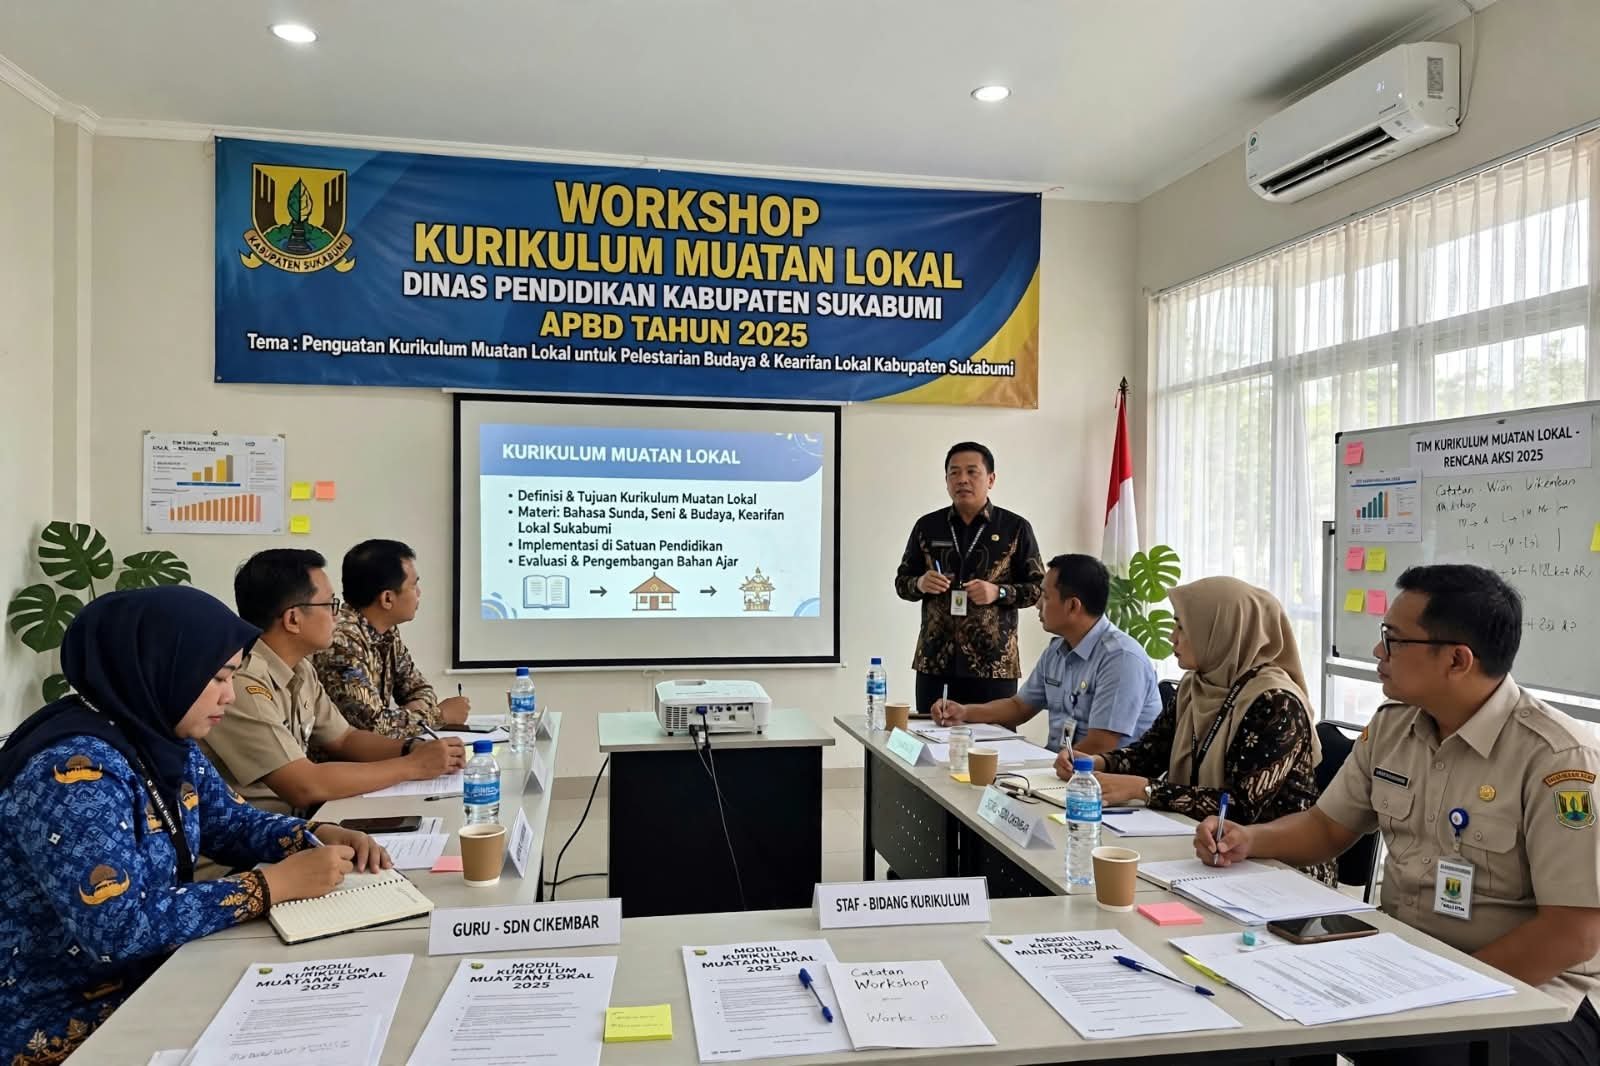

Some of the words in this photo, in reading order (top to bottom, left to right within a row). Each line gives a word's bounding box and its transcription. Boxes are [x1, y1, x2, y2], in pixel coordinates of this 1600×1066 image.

[555, 181, 820, 238] WORKSHOP
[249, 236, 300, 270] KABUPATEN
[304, 240, 349, 270] SUKABUMI
[415, 222, 663, 275] KURIKULUM
[675, 238, 834, 283] MUATAN
[845, 247, 963, 289] LOKAL
[403, 271, 488, 300] DINAS
[495, 275, 656, 307] PENDIDIKAN
[663, 284, 810, 315] KABUPATEN
[816, 292, 942, 320] SUKABUMI
[539, 311, 623, 341] APBD
[631, 316, 730, 346] TAHUN
[738, 321, 808, 348] 2025
[248, 333, 289, 351] Tema
[302, 335, 386, 356] Penguatan
[389, 339, 467, 358] Kurikulum
[471, 342, 527, 360] Muatan
[531, 344, 571, 361] Lokal
[575, 347, 617, 363] untuk
[621, 347, 700, 366] Pelestarian
[704, 351, 756, 371] Budaya
[760, 354, 770, 368] &
[774, 355, 831, 371] Kearifan
[835, 356, 871, 372] Lokal
[874, 357, 945, 376] Kabupaten
[949, 359, 1014, 377] Sukabumi
[1416, 440, 1432, 453] TIM
[1434, 434, 1489, 452] KURIKULUM
[1491, 430, 1535, 446] MUATAN
[1537, 426, 1573, 442] LOKAL
[502, 443, 606, 461] KURIKULUM
[611, 446, 682, 464] MUATAN
[686, 449, 741, 466] LOKAL
[1443, 453, 1489, 468] RENCANA
[1491, 450, 1515, 466] AKSI
[1517, 448, 1544, 463] 2025
[518, 489, 563, 503] Definisi
[566, 490, 575, 503] &
[577, 490, 617, 506] Tujuan
[620, 491, 679, 505] Kurikulum
[682, 492, 724, 505] Muatan
[727, 492, 757, 505] Lokal
[518, 506, 560, 519] Materi:
[563, 506, 606, 519] Bahasa
[608, 506, 648, 521] Sunda,
[651, 507, 676, 520] Seni
[679, 508, 688, 520] &
[690, 508, 735, 523] Budaya,
[738, 507, 785, 521] Kearifan
[518, 522, 550, 535] Lokal
[553, 522, 612, 535] Sukabumi
[518, 539, 599, 553] Implementasi
[601, 539, 613, 552] di
[616, 539, 657, 552] Satuan
[659, 540, 723, 552] Pendidikan
[518, 555, 568, 568] Evaluasi
[570, 556, 579, 568] &
[582, 555, 674, 571] Pengembangan
[677, 556, 713, 569] Bahan
[715, 556, 739, 570] Ajar
[836, 898, 860, 913] STAF
[870, 896, 909, 911] BIDANG
[911, 893, 970, 910] KURIKULUM
[452, 921, 489, 938] GURU
[503, 919, 531, 936] SDN
[533, 915, 600, 934] CIKEMBAR
[734, 945, 781, 954] MODUL
[303, 962, 356, 972] MODUL
[512, 961, 563, 969] MODUL
[773, 955, 817, 964] LOKAL
[338, 971, 388, 982] LOKAL
[547, 972, 595, 981] LOKAL
[746, 965, 782, 973] 2025
[850, 967, 905, 978] Catatan
[300, 982, 341, 992] 2025
[512, 981, 550, 989] 2025
[854, 977, 929, 991] Workshop
